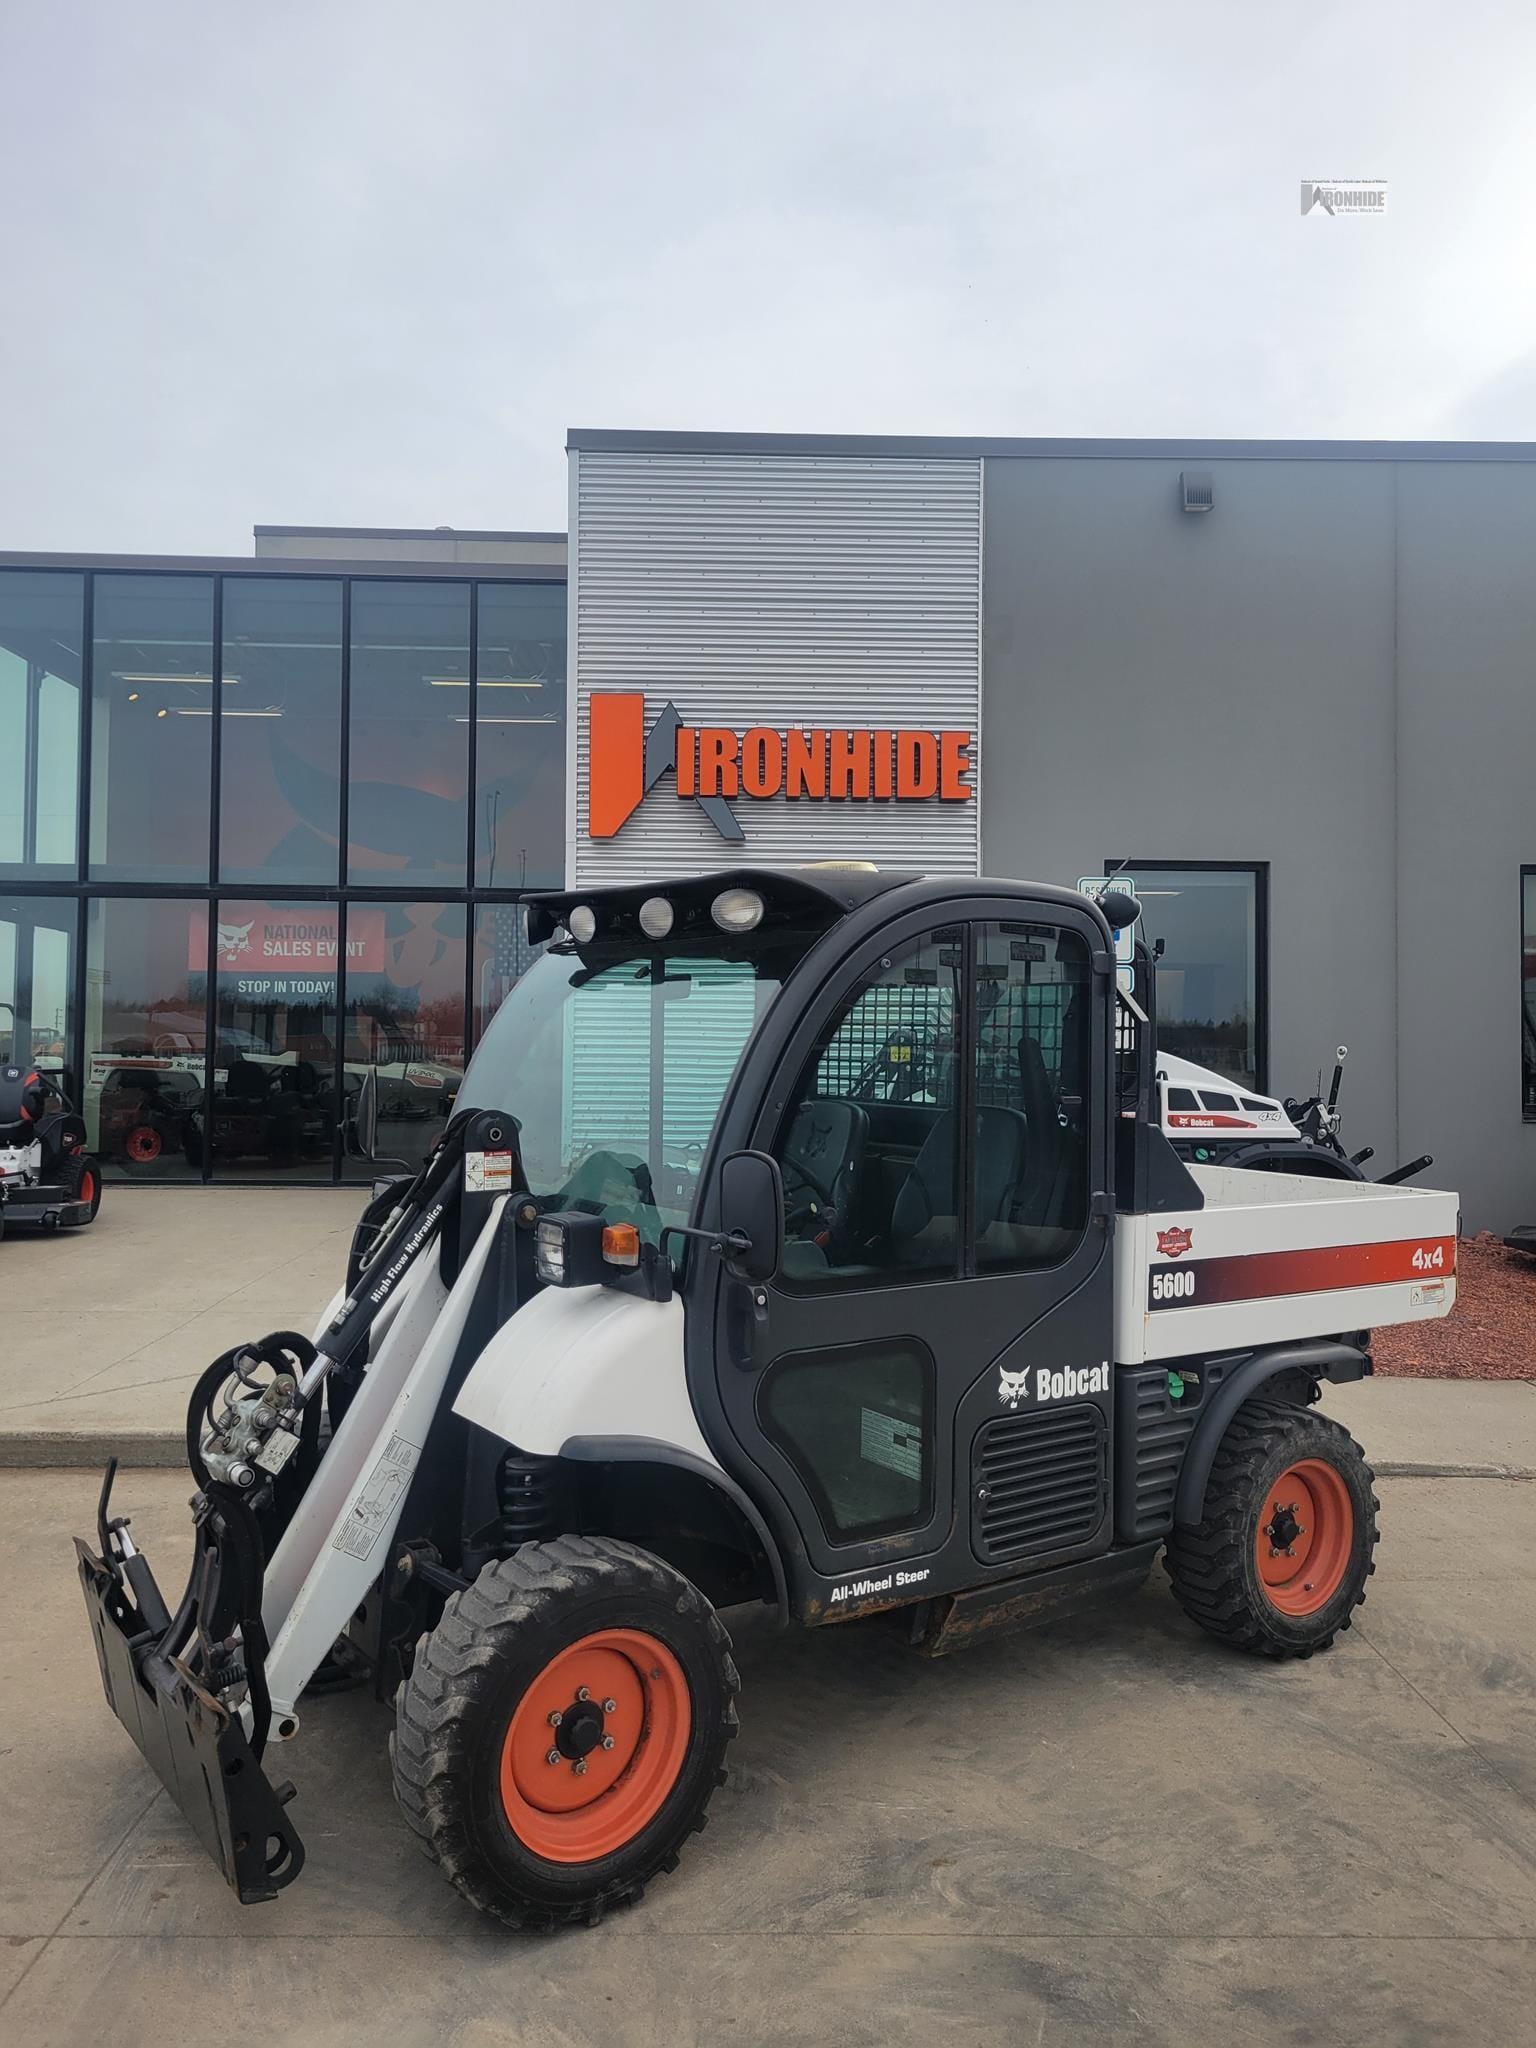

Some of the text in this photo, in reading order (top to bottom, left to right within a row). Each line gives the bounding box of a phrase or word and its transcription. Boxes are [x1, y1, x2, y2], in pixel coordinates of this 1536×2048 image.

[677, 727, 971, 800] IRONHIDE
[264, 925, 337, 939] NATIONAL
[263, 941, 365, 957] SALES EVNT
[238, 981, 335, 993] STOP IN TODAY!
[187, 1062, 206, 1070] Bobc
[1190, 1118, 1214, 1127] Bobcat
[1258, 1111, 1282, 1121] 4x4
[370, 1203, 443, 1303] High Flow Hydraulics
[1412, 1246, 1444, 1269] 4x4
[1152, 1271, 1195, 1299] 5600
[1037, 1361, 1109, 1401] Bobcat
[831, 1569, 930, 1602] All-Wheel Steer
